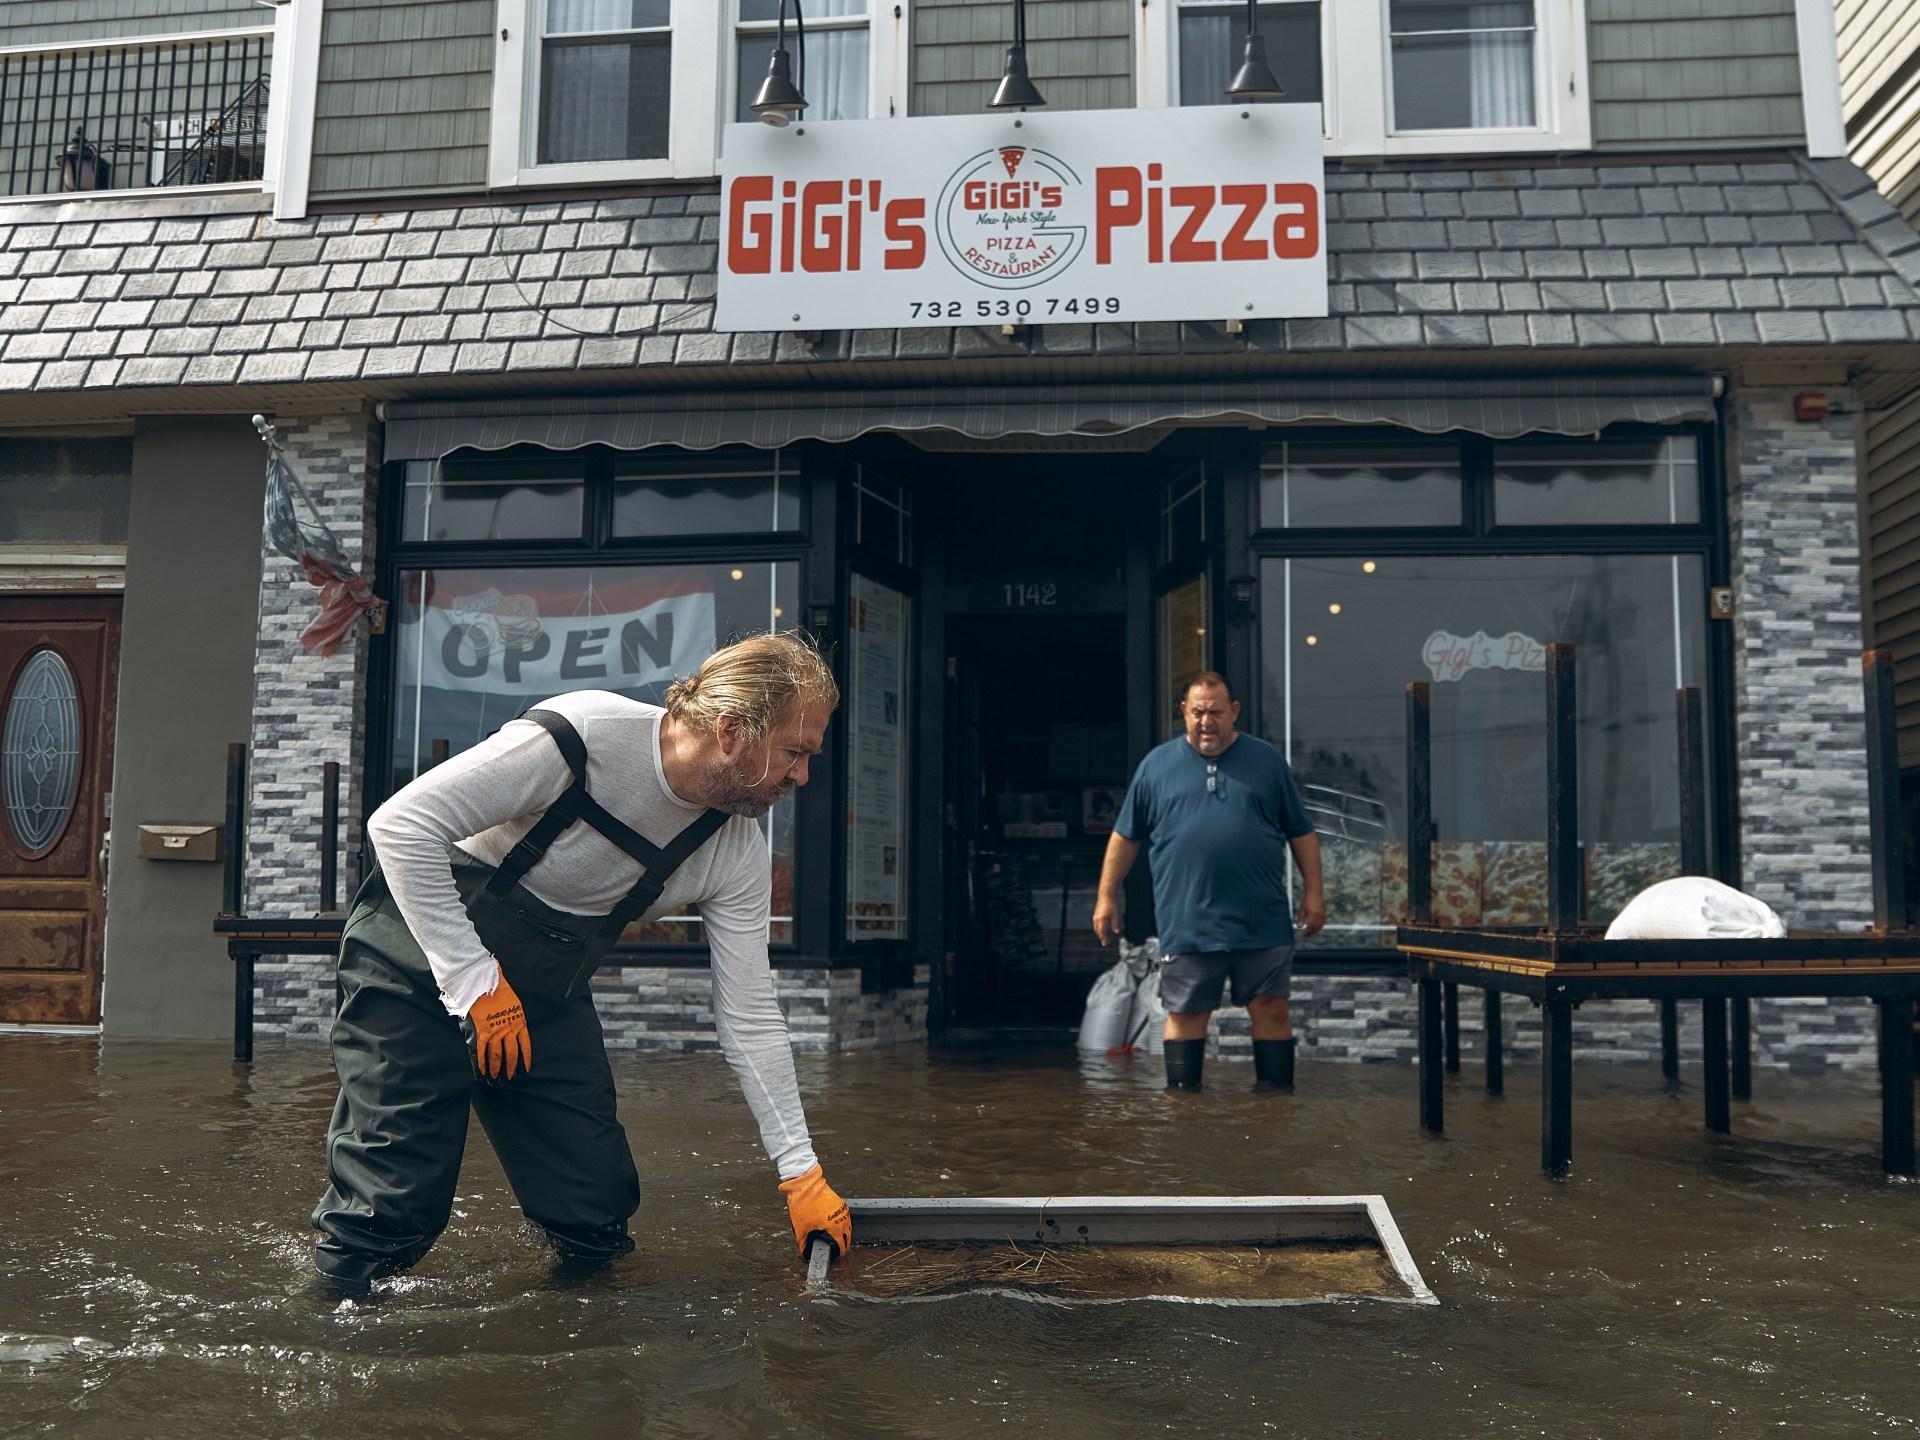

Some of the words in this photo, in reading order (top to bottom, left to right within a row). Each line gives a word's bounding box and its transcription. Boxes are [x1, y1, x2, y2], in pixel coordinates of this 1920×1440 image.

[964, 181, 1062, 210] GiGi's
[728, 175, 926, 274] GiGi's
[1096, 163, 1320, 265] Pizza
[976, 212, 1000, 226] New
[1002, 211, 1028, 230] York
[1030, 210, 1057, 229] Style
[986, 237, 1037, 251] PIZZA
[965, 245, 1057, 275] RESTAURANT
[1008, 252, 1018, 264] &
[910, 302, 962, 319] 732
[977, 299, 1031, 317] 530
[1046, 297, 1121, 315] 7499
[1001, 582, 1057, 607] 1142
[441, 612, 674, 683] OPEN
[1505, 635, 1546, 668] Piz
